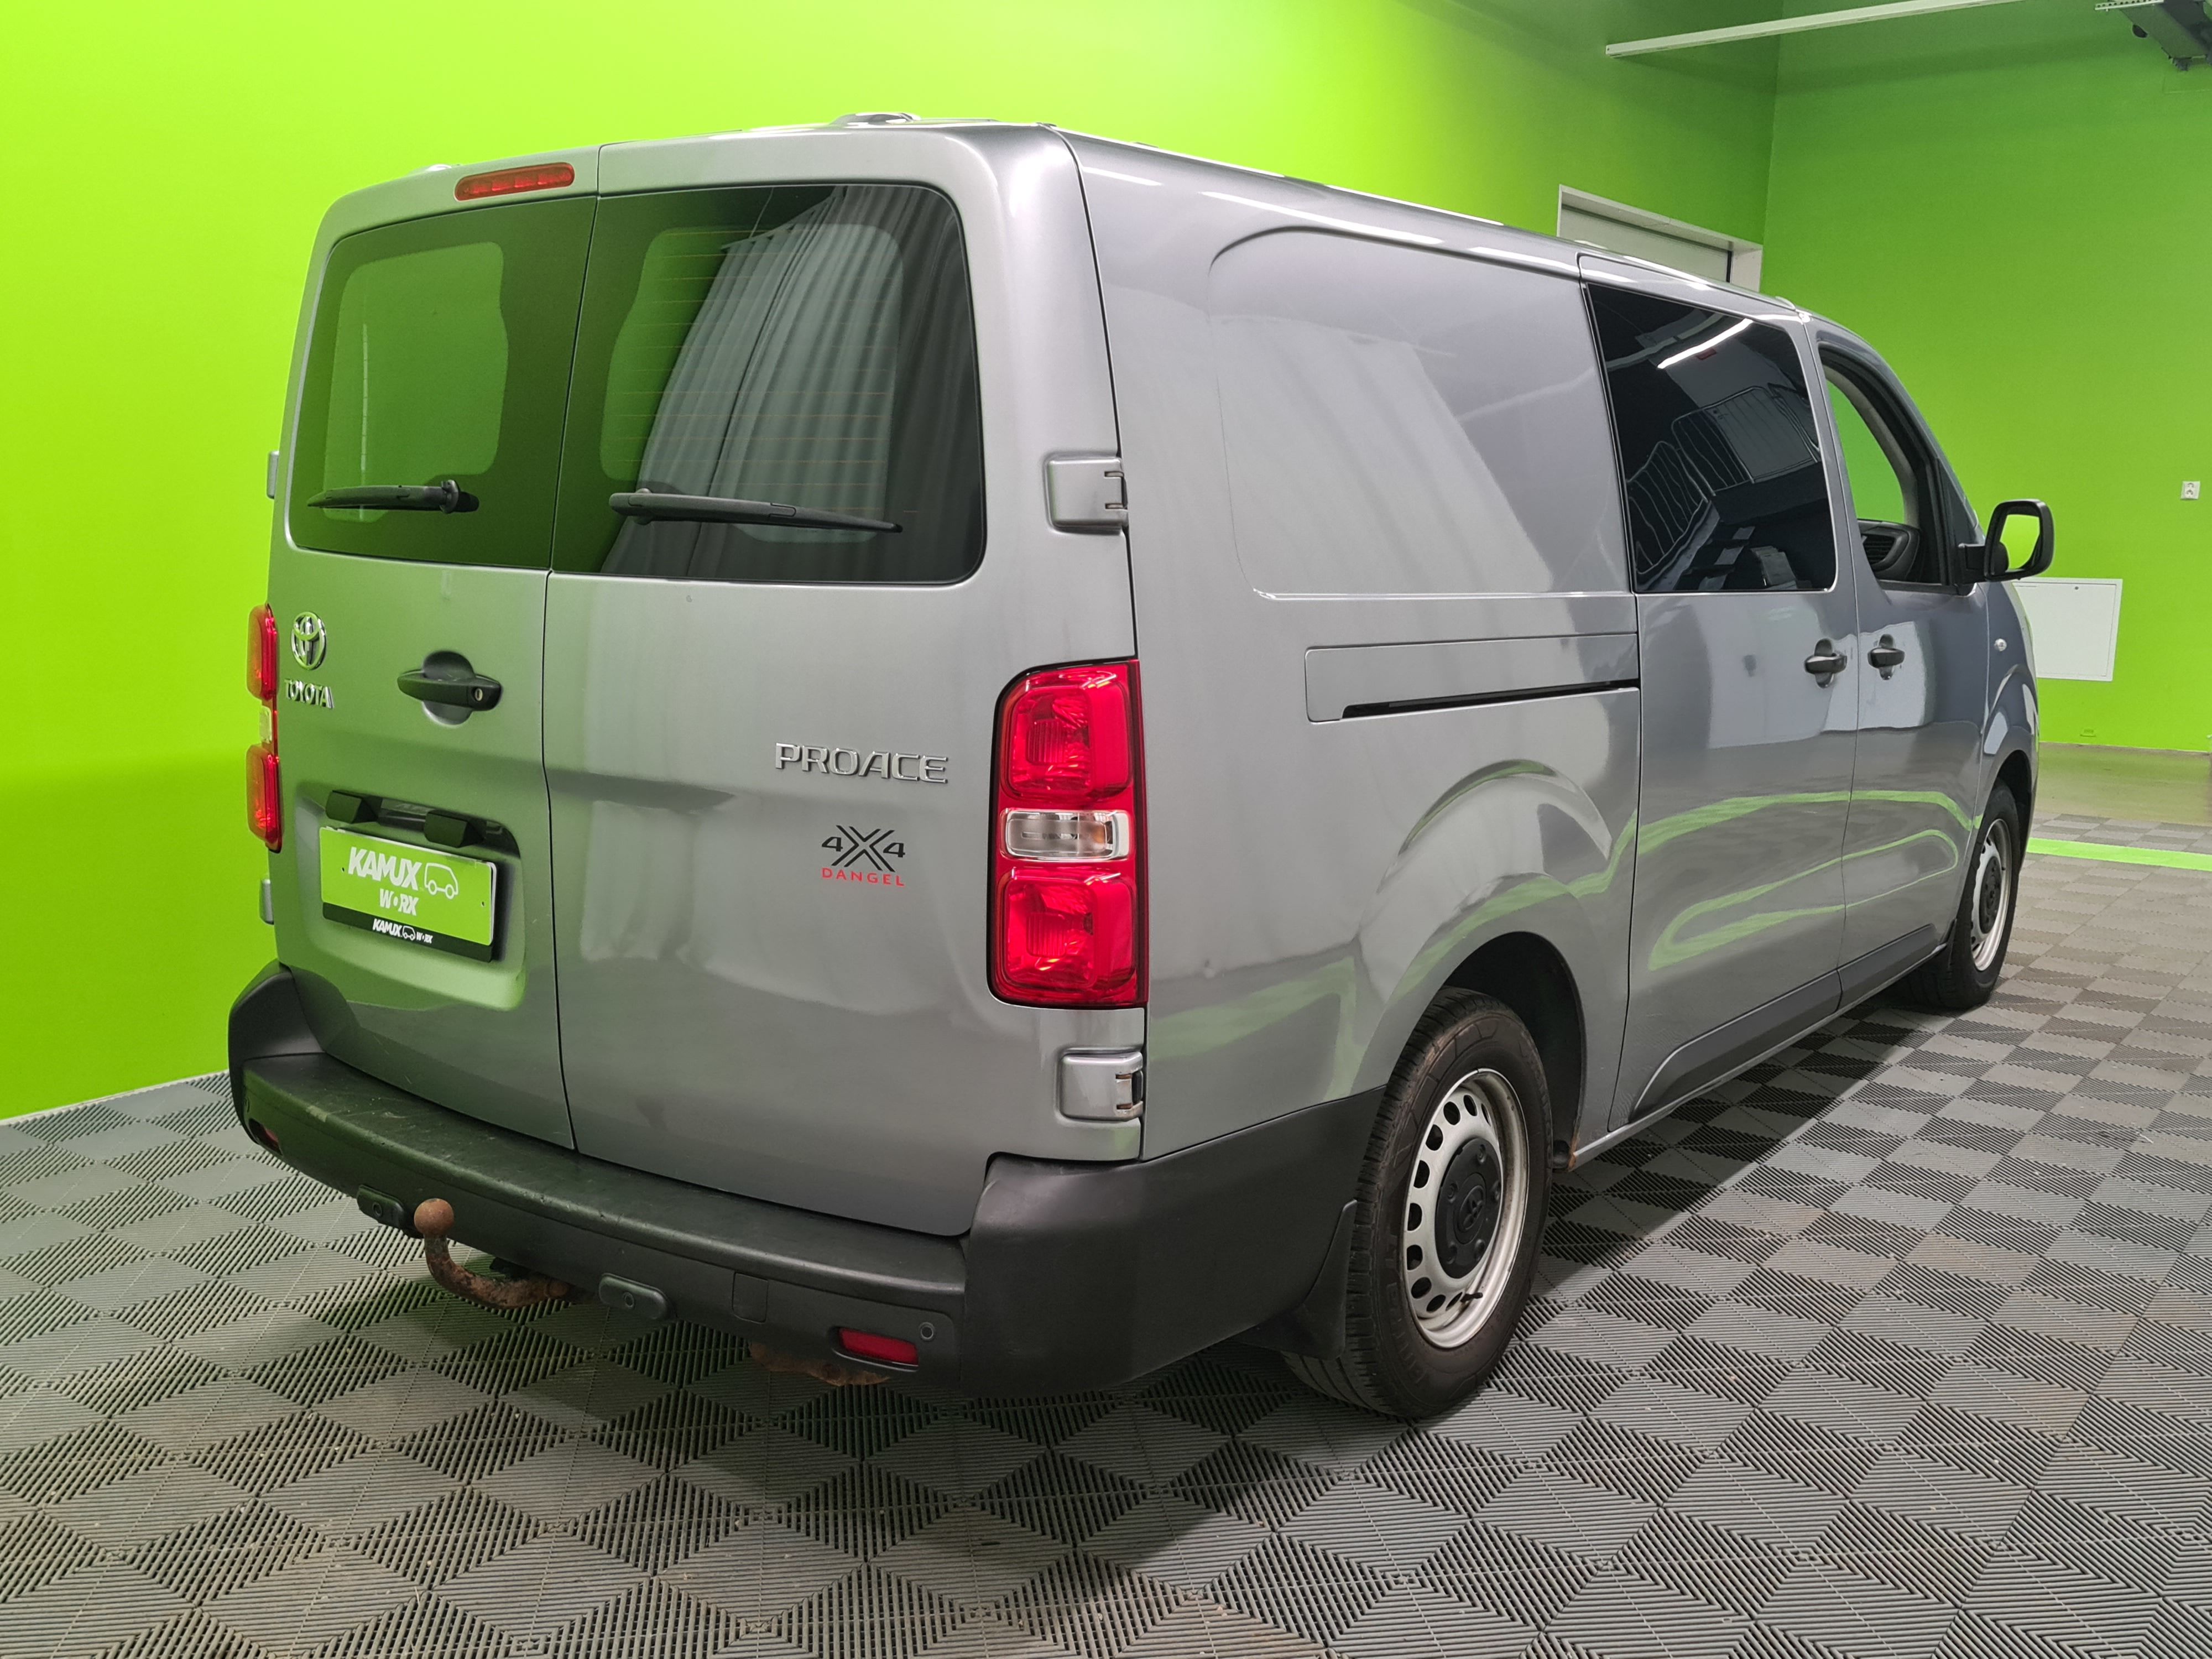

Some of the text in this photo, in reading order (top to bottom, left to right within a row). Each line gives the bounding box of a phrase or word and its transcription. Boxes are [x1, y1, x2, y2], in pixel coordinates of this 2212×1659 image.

[284, 678, 334, 709] TOYOTA
[775, 742, 949, 784] PROACE
[348, 846, 422, 891] KAMUX
[821, 867, 905, 886] DANGEL
[372, 918, 403, 937] KAMUX
